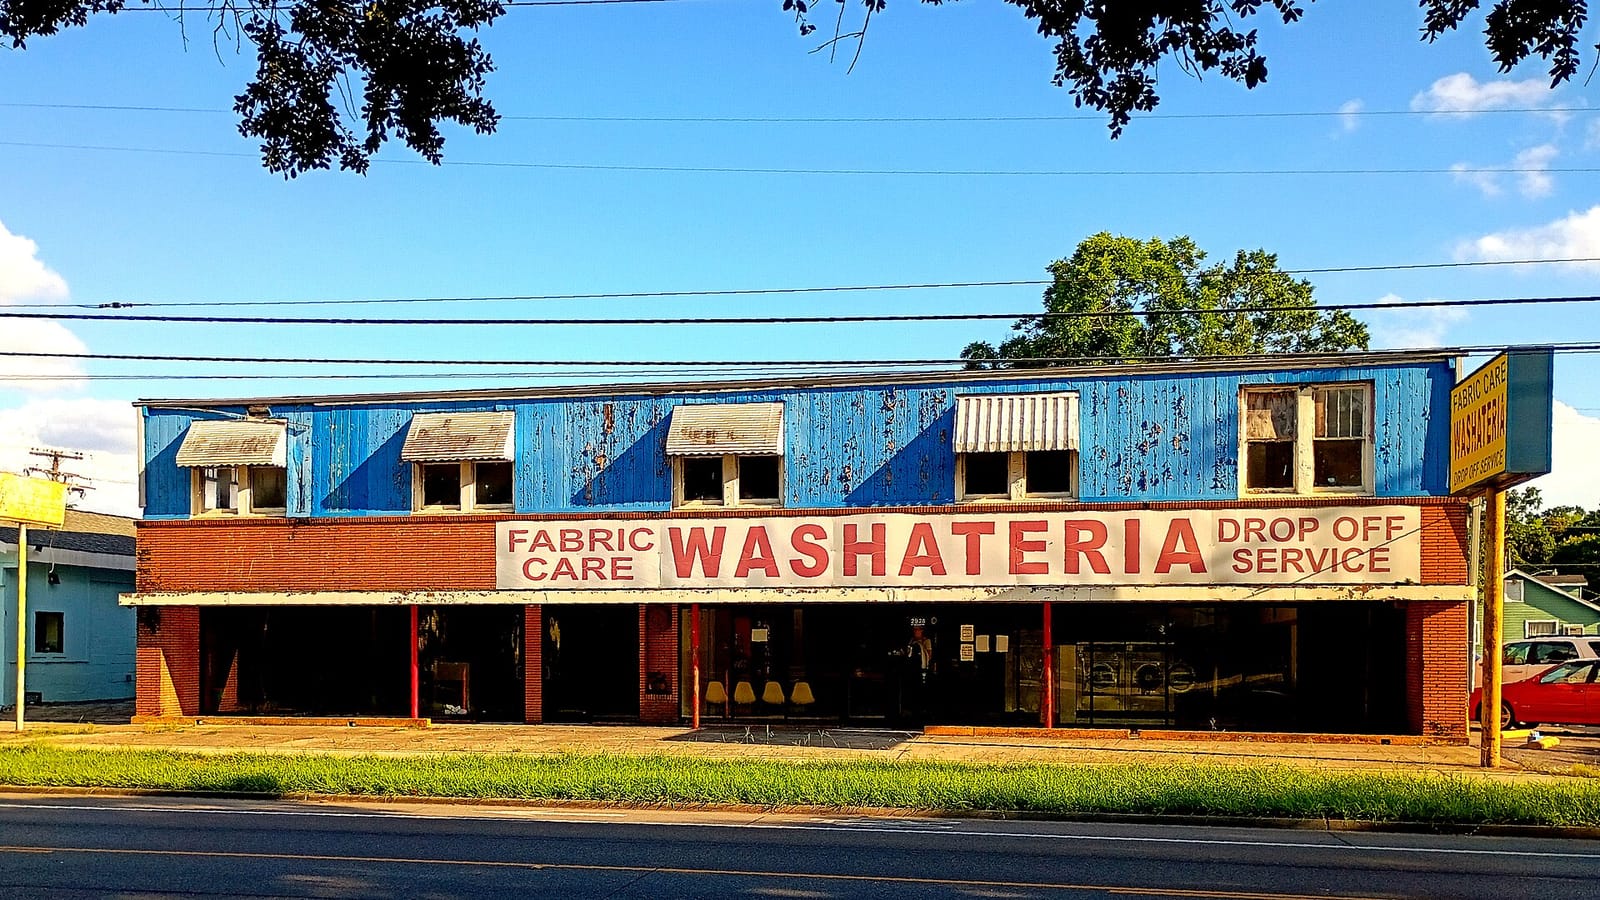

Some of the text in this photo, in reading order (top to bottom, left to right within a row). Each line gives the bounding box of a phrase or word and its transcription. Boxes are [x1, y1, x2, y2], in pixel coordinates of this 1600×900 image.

[1453, 360, 1506, 414] FABRIC CARE
[1453, 392, 1505, 461] WASHATERIA
[1453, 448, 1504, 486] DROP OFF SERVICE
[508, 527, 654, 552] FABRIC
[1218, 516, 1406, 543] DROP OFF
[668, 518, 1207, 578] WASHATERIA
[1232, 547, 1391, 574] SERVICE
[522, 557, 633, 581] CARE
